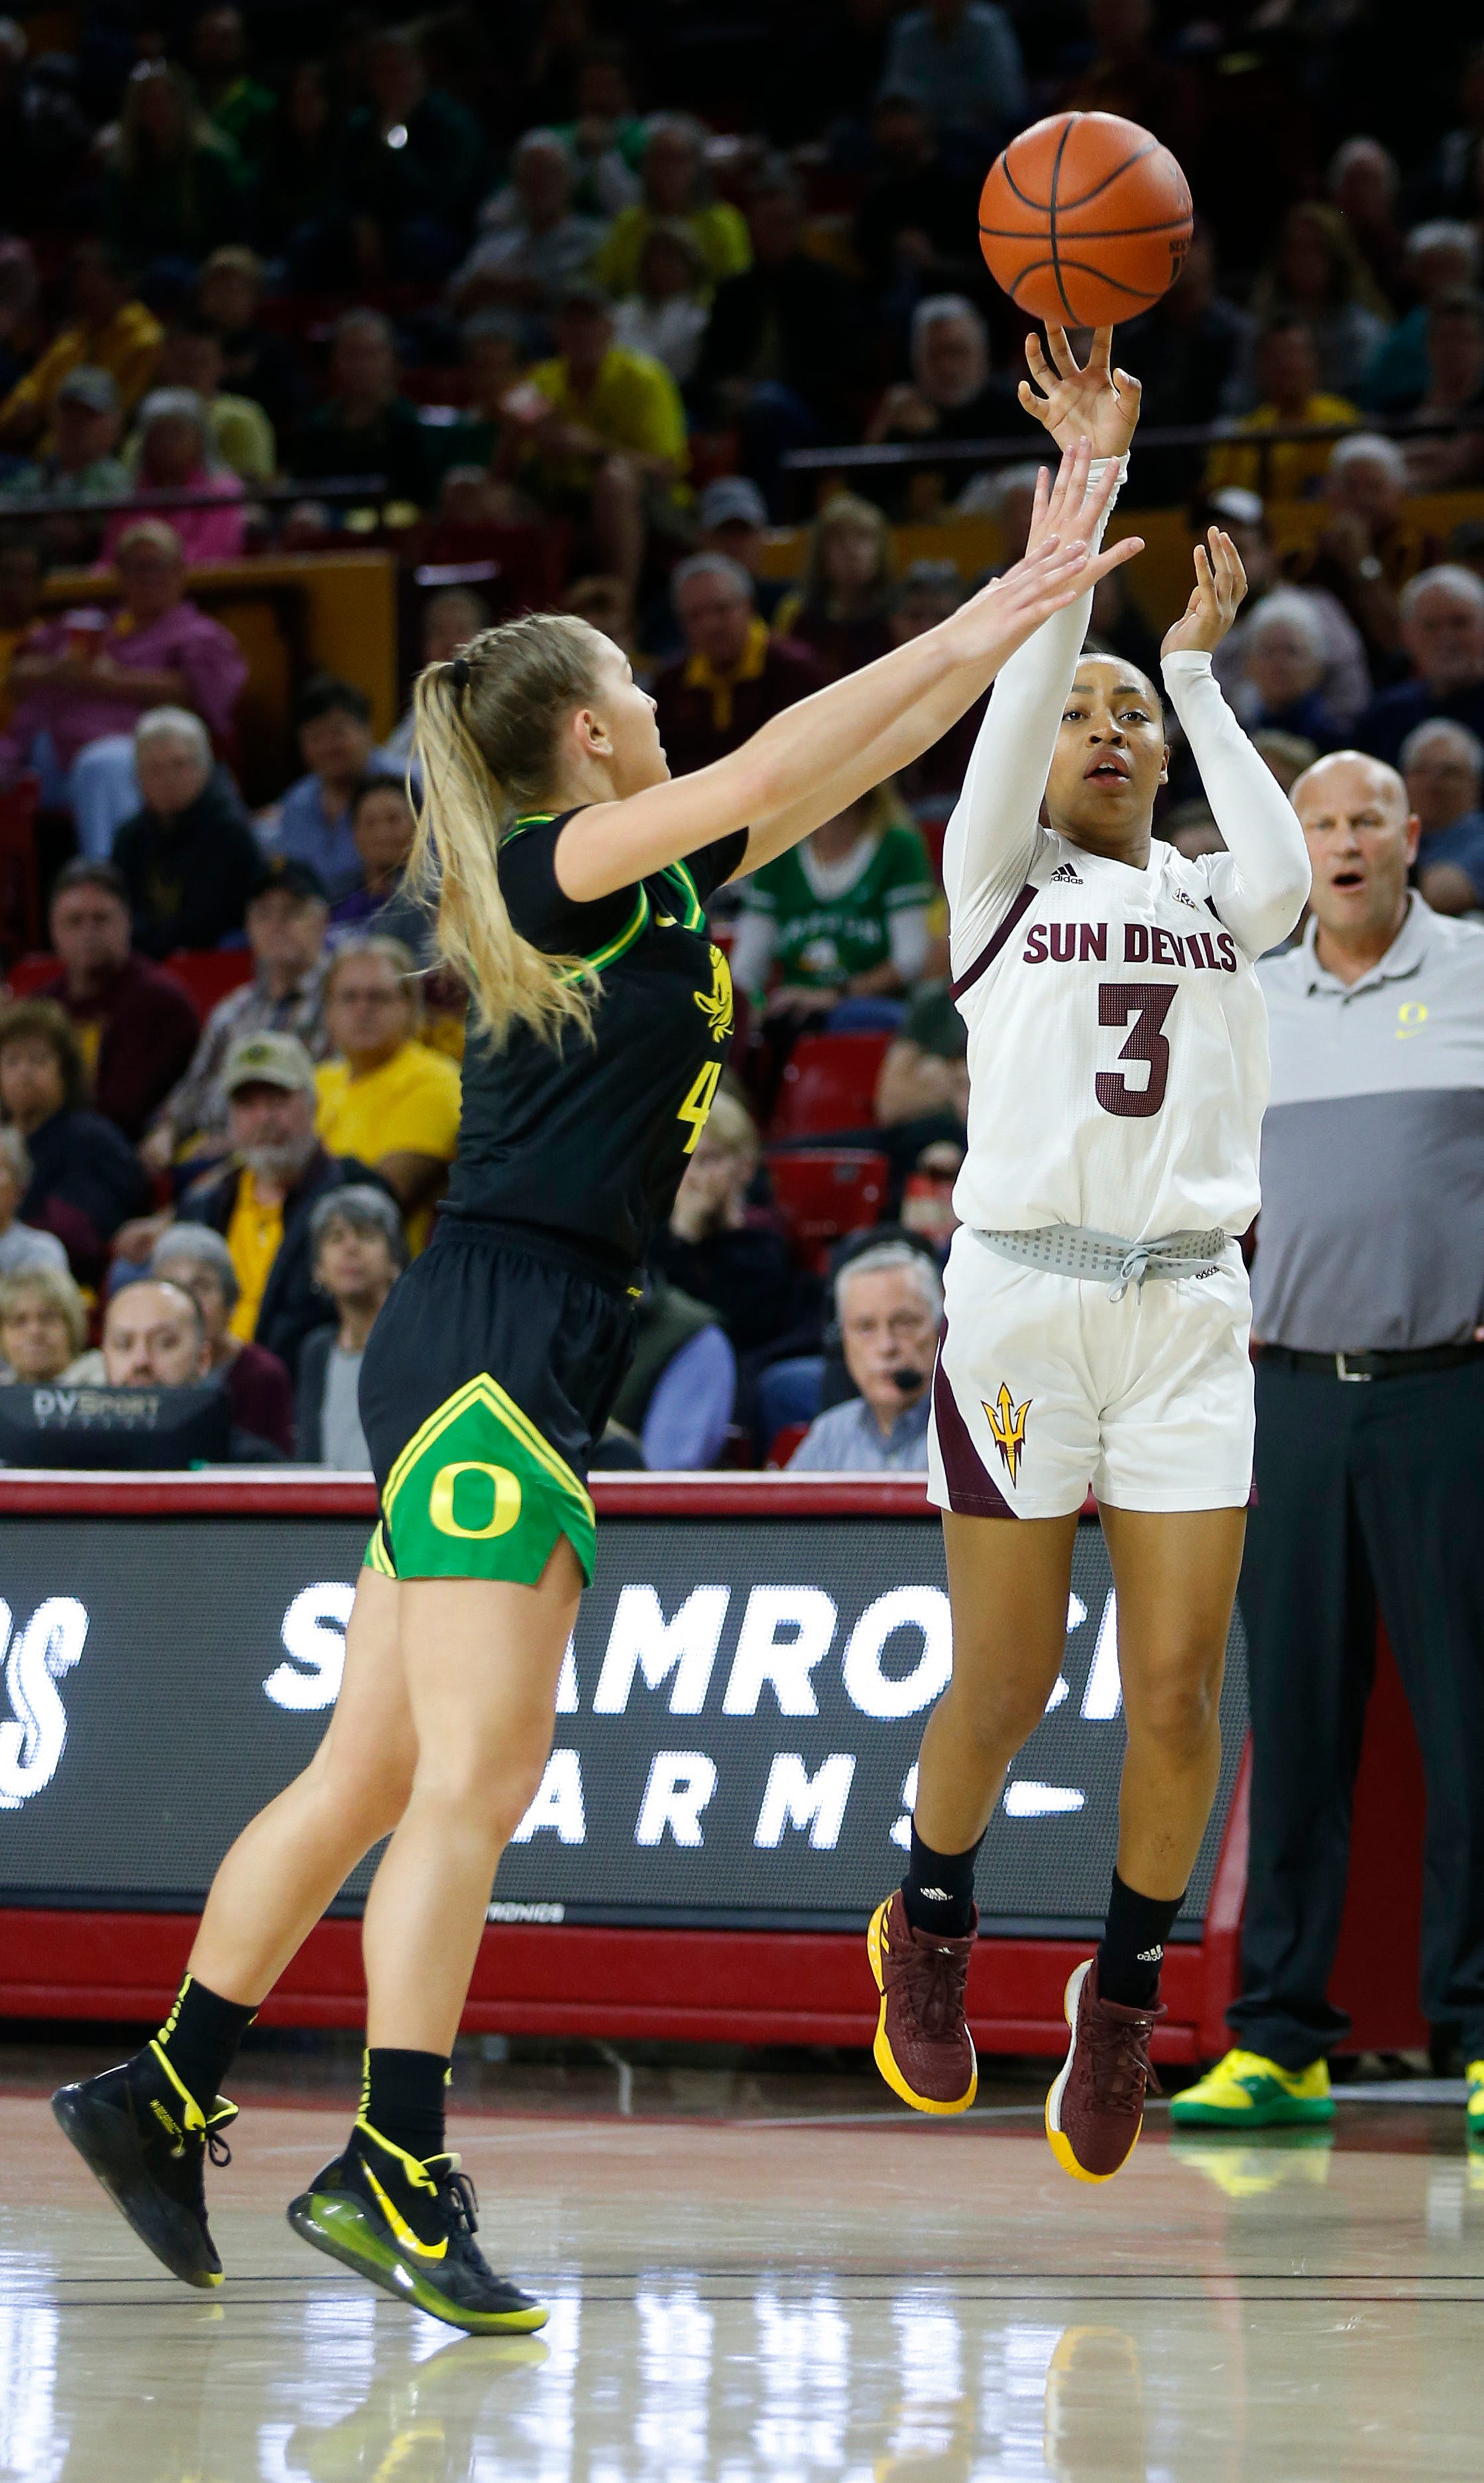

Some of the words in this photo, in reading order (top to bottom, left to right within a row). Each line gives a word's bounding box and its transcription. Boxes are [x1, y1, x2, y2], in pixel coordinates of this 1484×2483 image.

[1050, 874, 1084, 885] didas
[1023, 923, 1109, 964] SUN
[1123, 923, 1237, 972] DEVILS
[1095, 983, 1179, 1117] 3
[676, 1061, 722, 1154] 4
[429, 1461, 522, 1539] O
